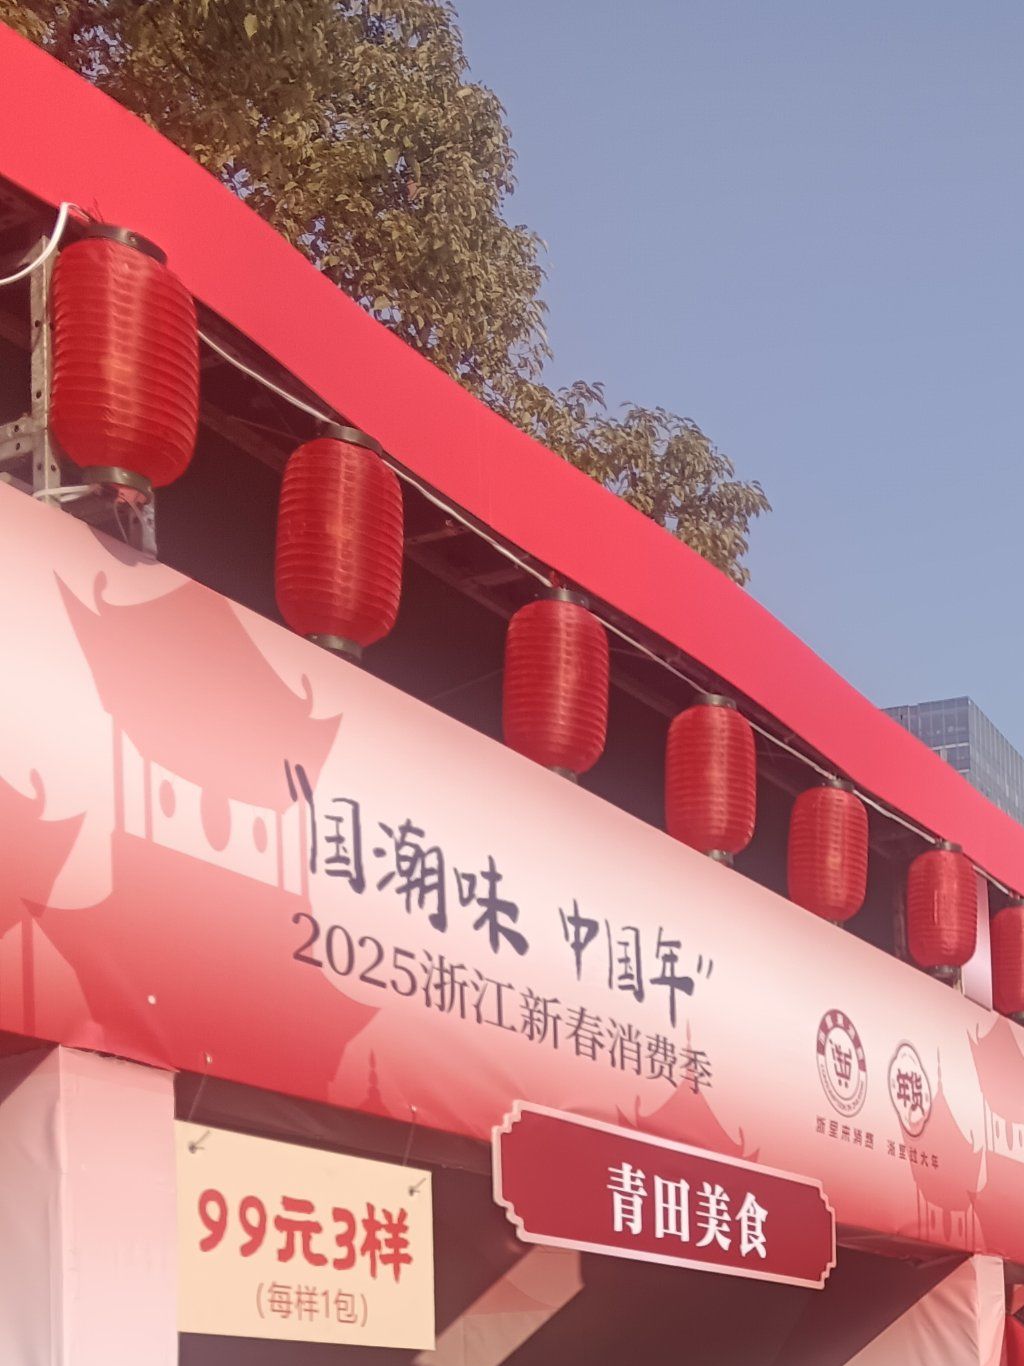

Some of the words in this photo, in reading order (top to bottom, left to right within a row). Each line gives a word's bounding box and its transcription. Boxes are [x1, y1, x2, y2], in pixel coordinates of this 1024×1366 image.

[291, 911, 714, 1095] 2025浙江新春消费季
[198, 1188, 413, 1284] 99元3样
[606, 1161, 769, 1259] 青田美食
